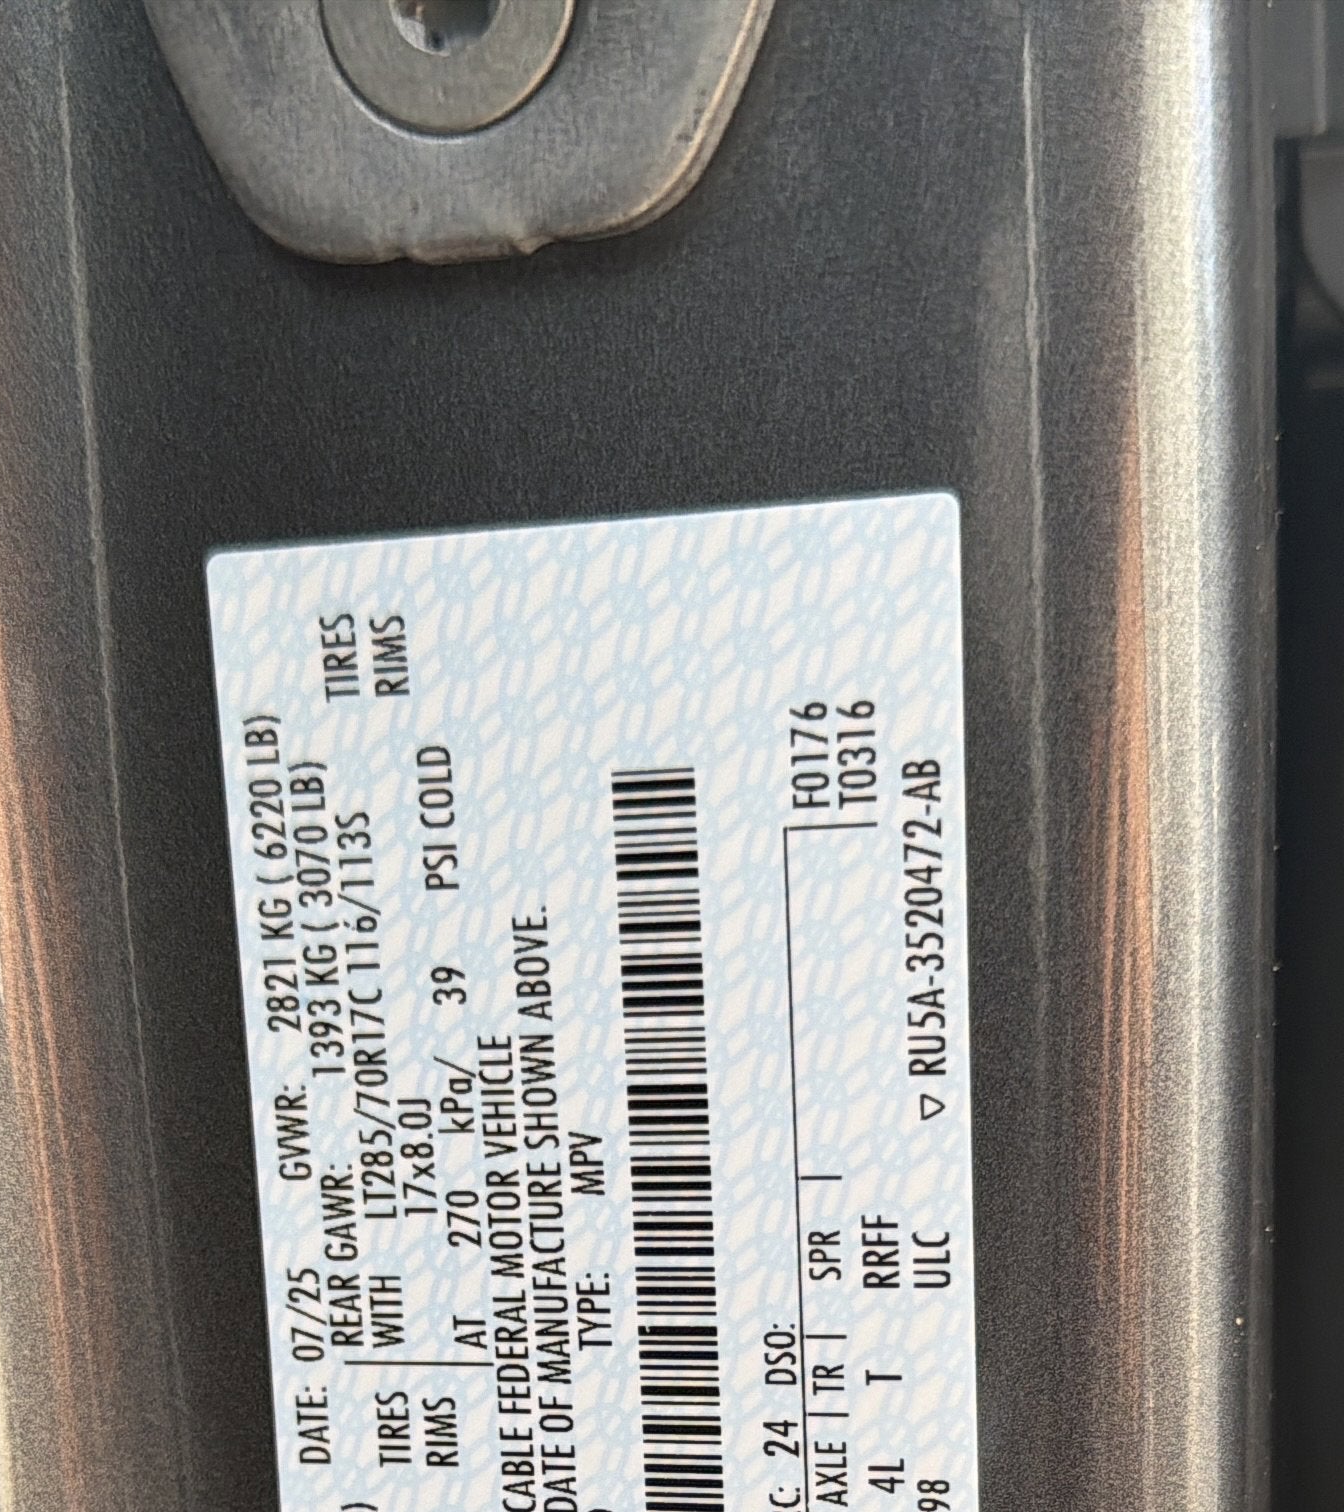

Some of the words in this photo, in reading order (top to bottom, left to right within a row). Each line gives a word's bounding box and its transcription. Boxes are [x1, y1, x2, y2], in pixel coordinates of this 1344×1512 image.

[320, 613, 360, 701] TIRES
[369, 615, 410, 696] RIMS
[242, 715, 281, 764] LB)
[791, 701, 830, 809] F0176
[837, 701, 877, 809] T0316
[249, 779, 287, 860] 6220
[289, 761, 327, 811] LB)
[417, 746, 456, 829] COLD
[296, 825, 333, 907] 3070
[336, 811, 382, 972] 116/113S
[424, 843, 459, 890] PSI
[259, 897, 294, 940] KG
[901, 760, 946, 1076] RU5A-3520472-AB
[264, 957, 301, 1031] 2821
[303, 944, 339, 986] KG
[431, 966, 467, 1005] 39
[512, 905, 554, 1020] ABOVE.
[310, 1000, 346, 1077] 1393
[351, 988, 398, 1220] LT285/70R17C
[434, 1056, 475, 1134] kPa/
[478, 1034, 517, 1157] VEHICLE
[520, 1033, 560, 1150] SHOWN
[276, 1085, 311, 1181] GVWR:
[399, 1098, 439, 1217] 17x8.0J
[569, 1132, 606, 1196] MPV
[322, 1165, 356, 1261] GAWR:
[446, 1190, 482, 1247] 270
[488, 1170, 524, 1278] MOTOR
[861, 1213, 899, 1288] RRFF
[527, 1161, 571, 1384] MANUFACTURE
[809, 1230, 841, 1280] SPR
[913, 1231, 950, 1288] ULC
[286, 1268, 325, 1362] 07/25
[329, 1274, 364, 1346] REAR
[369, 1274, 405, 1348] WITH
[453, 1315, 488, 1349] AT
[578, 1272, 612, 1351] TYPE:
[493, 1289, 532, 1414] FEDERAL
[764, 1323, 796, 1385] DSO:
[812, 1364, 845, 1395] TR
[866, 1369, 902, 1386] T
[295, 1386, 332, 1464] DATE:
[376, 1391, 413, 1466] TIRES
[423, 1397, 459, 1466] RIMS
[539, 1394, 574, 1433] OF
[764, 1421, 799, 1457] 24
[814, 1441, 848, 1507] AXLE
[869, 1458, 904, 1494] 4L
